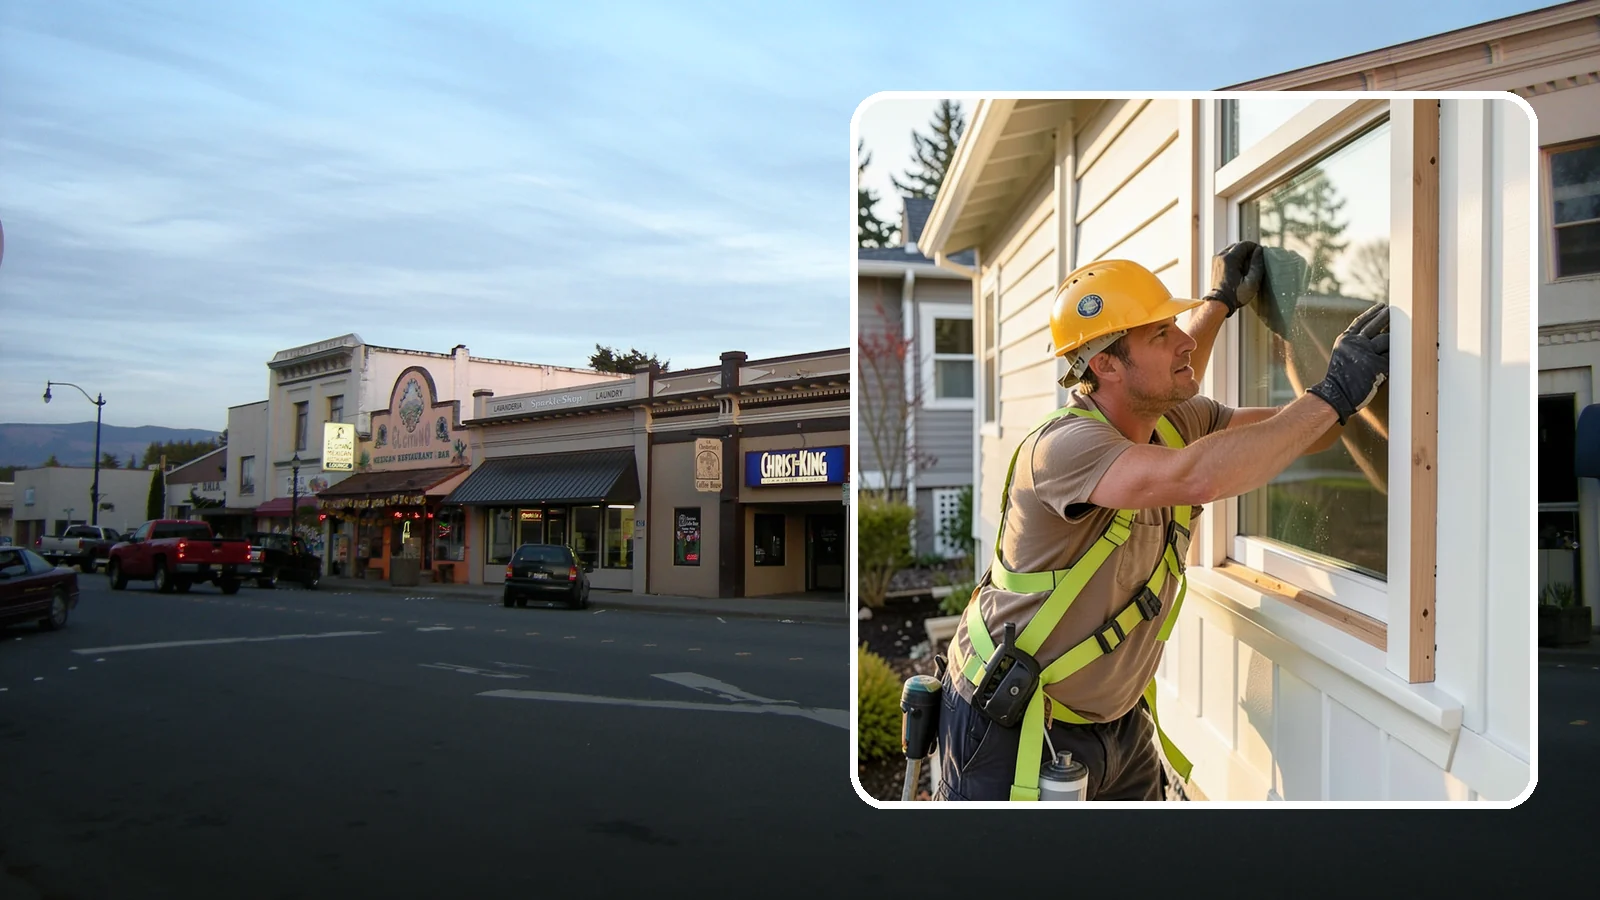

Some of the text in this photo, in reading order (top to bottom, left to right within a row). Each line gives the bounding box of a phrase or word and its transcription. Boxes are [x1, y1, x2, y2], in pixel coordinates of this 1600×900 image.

[494, 389, 623, 412] LAVANDERIA Sparkle Shop LAUNDRY
[373, 450, 450, 464] MEXICAN RESTAURANT BAR
[696, 480, 722, 489] Coffee House
